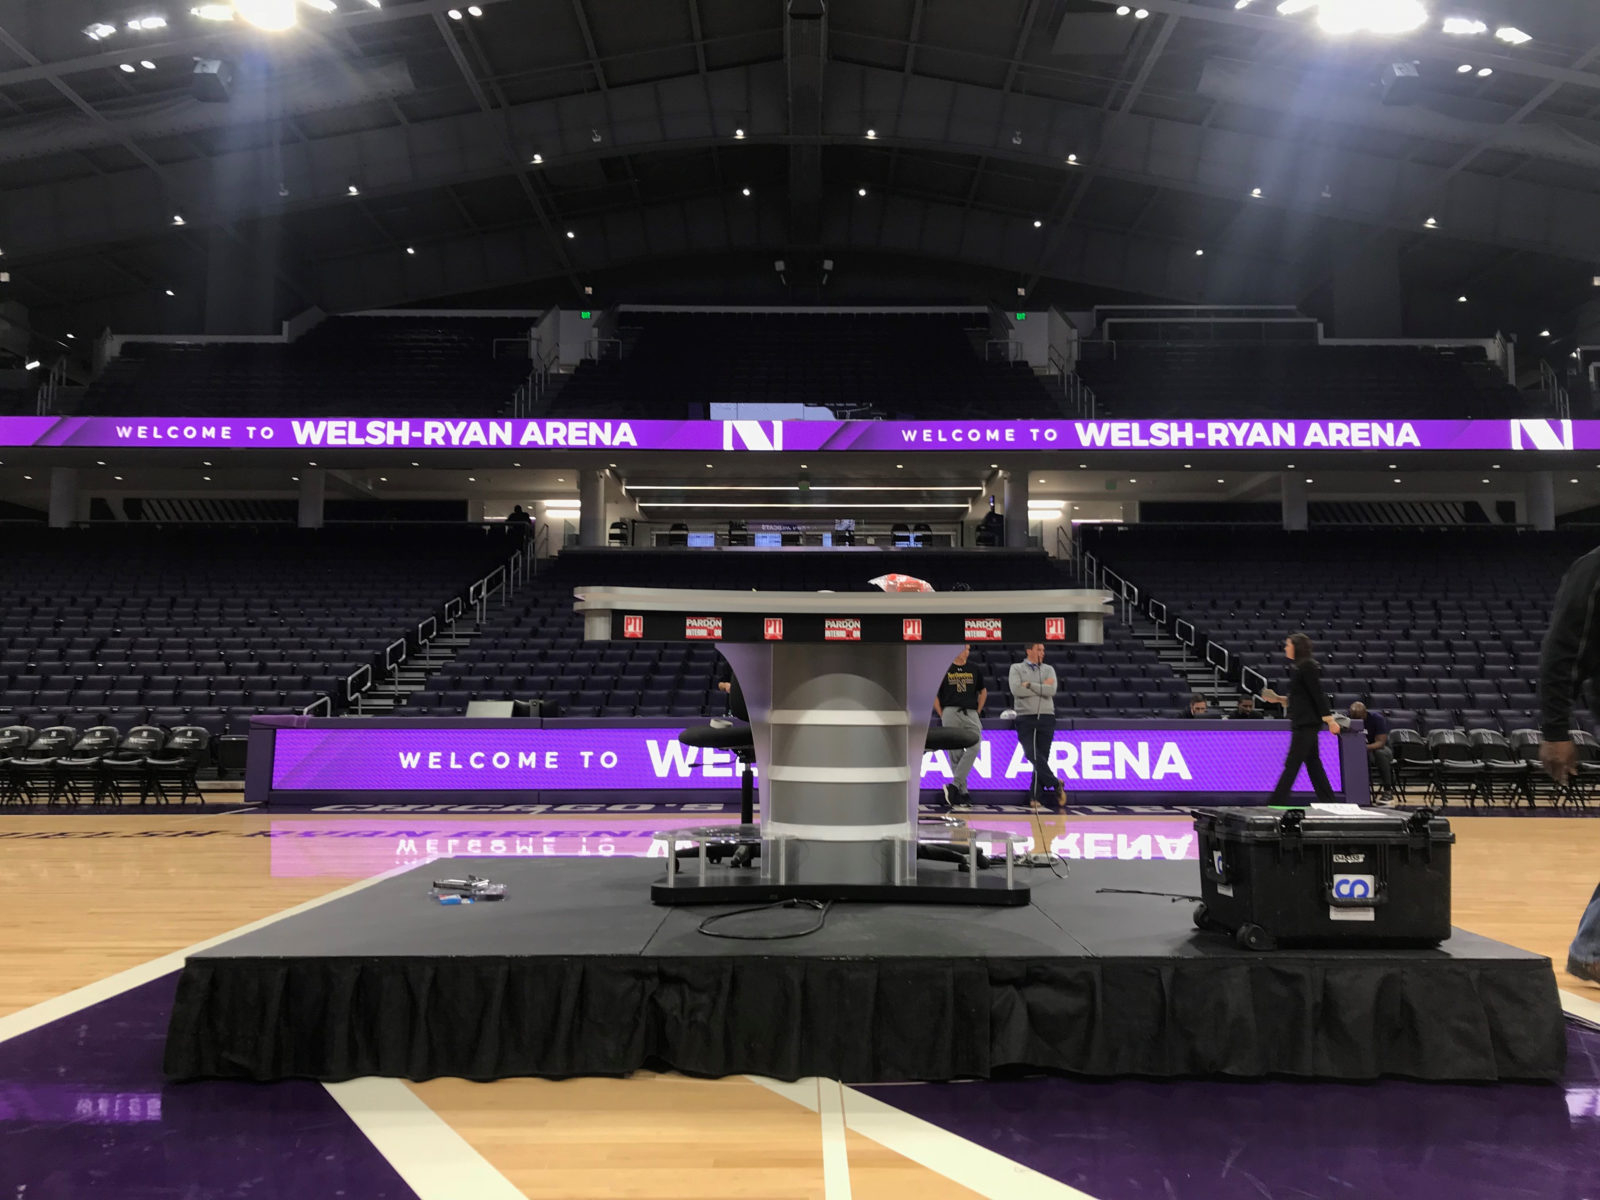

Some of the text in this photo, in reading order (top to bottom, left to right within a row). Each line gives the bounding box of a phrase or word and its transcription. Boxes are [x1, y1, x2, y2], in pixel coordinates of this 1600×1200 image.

[115, 420, 638, 447] WELCOME TO WELSH-RYAN ARENA
[901, 422, 1421, 448] WELCOME TO WELSH-RYAN ARENA
[624, 616, 643, 633] PTI
[686, 618, 722, 627] PARDON
[764, 618, 783, 635] PTI
[825, 620, 861, 629] PARDON
[903, 619, 922, 635] PTI
[965, 620, 1001, 629] PARDON
[1046, 618, 1065, 635] PTI
[398, 751, 559, 769] WELCOME
[580, 751, 618, 769] TO
[312, 802, 724, 812] CHICAGO'S
